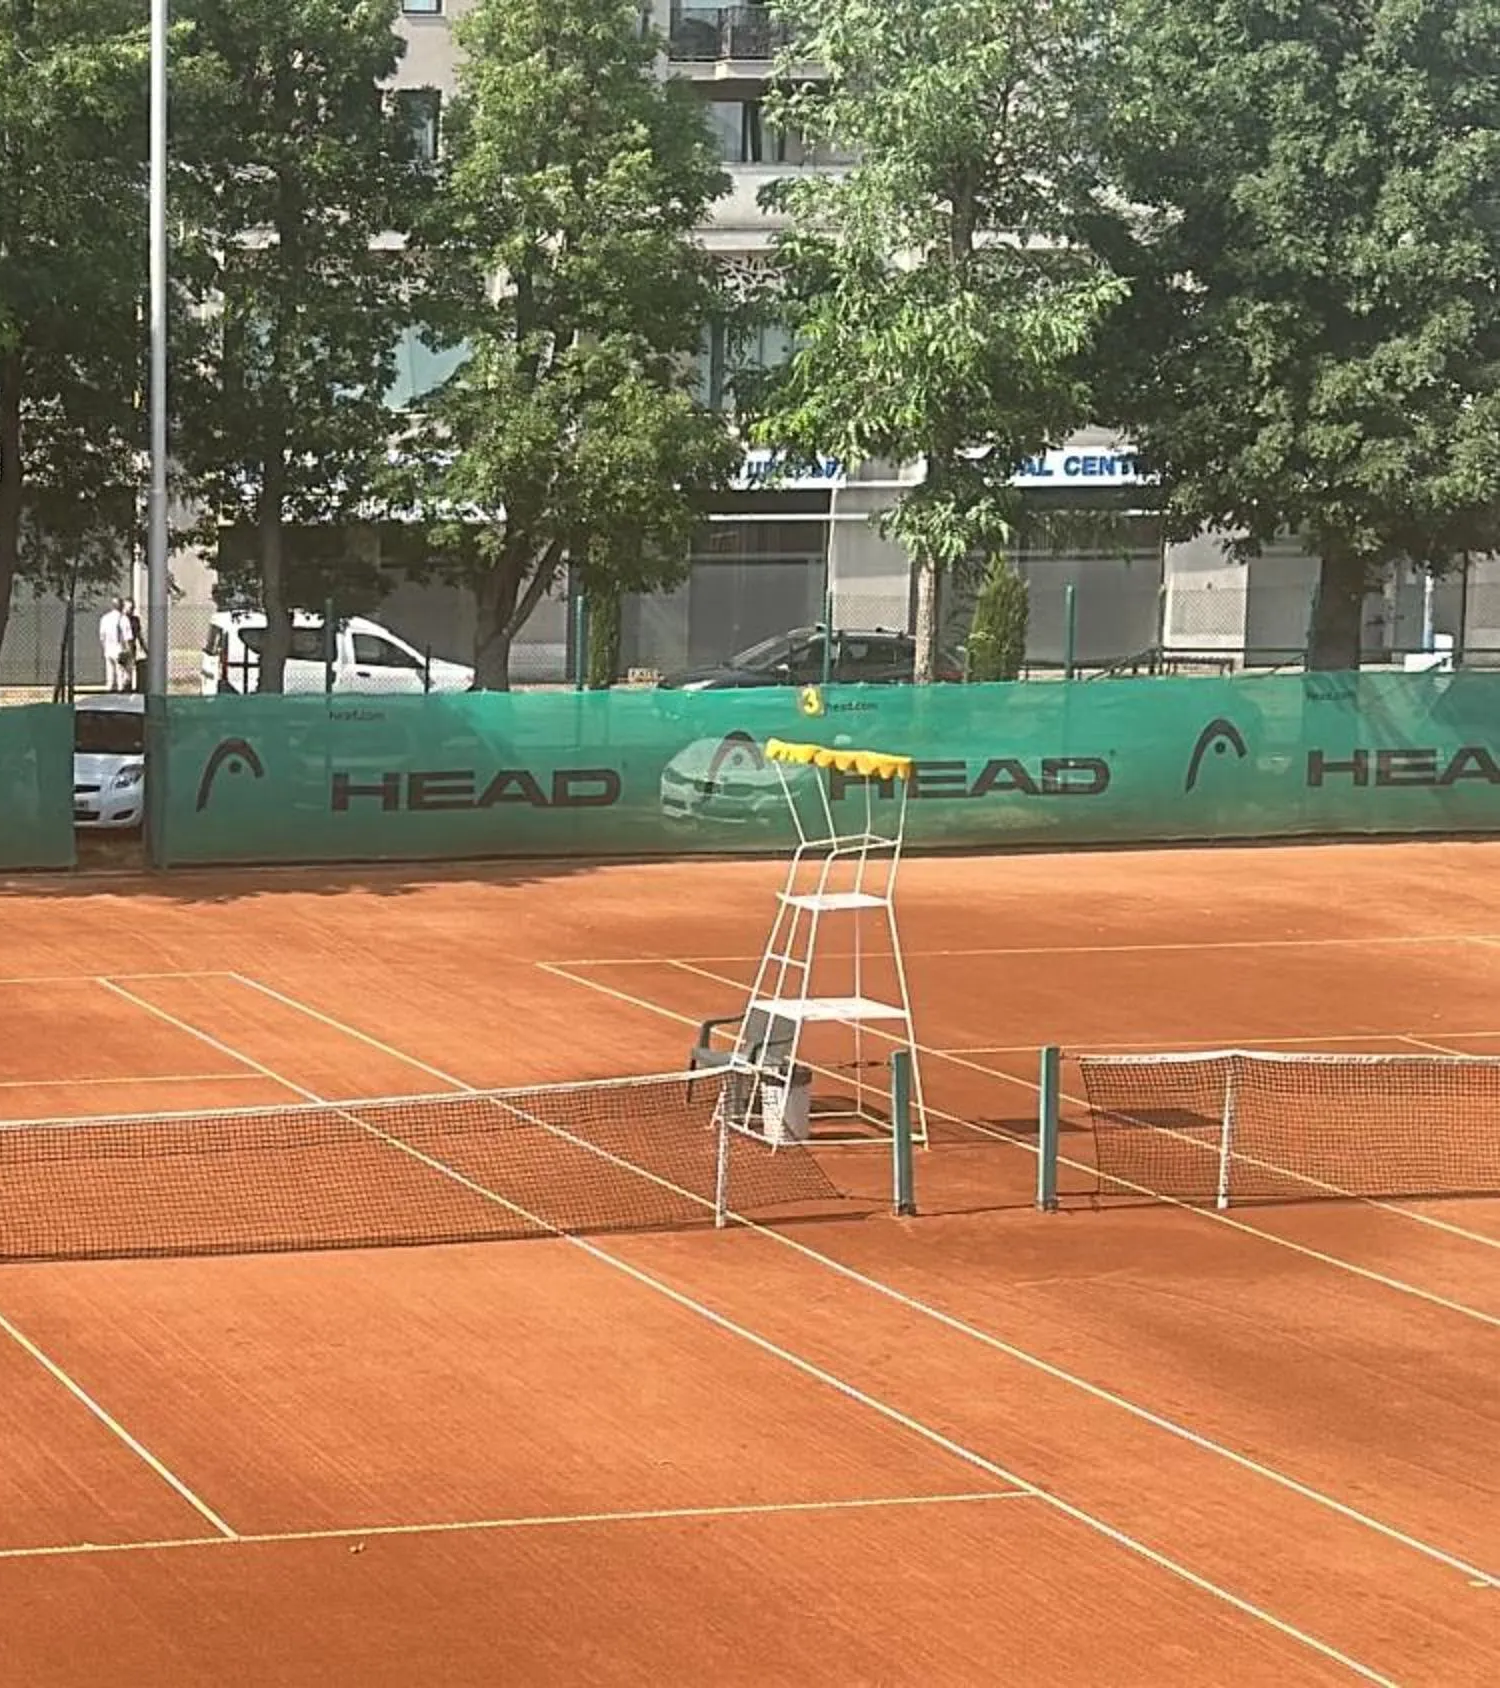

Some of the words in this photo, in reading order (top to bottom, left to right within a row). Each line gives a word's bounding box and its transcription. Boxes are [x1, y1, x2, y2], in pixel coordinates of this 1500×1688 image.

[1014, 456, 1053, 476] AL
[1064, 455, 1141, 477] CENT
[802, 687, 820, 715] 3
[829, 758, 1112, 800] HEAD
[1307, 746, 1500, 787] HEA
[332, 768, 622, 812] HEAD
